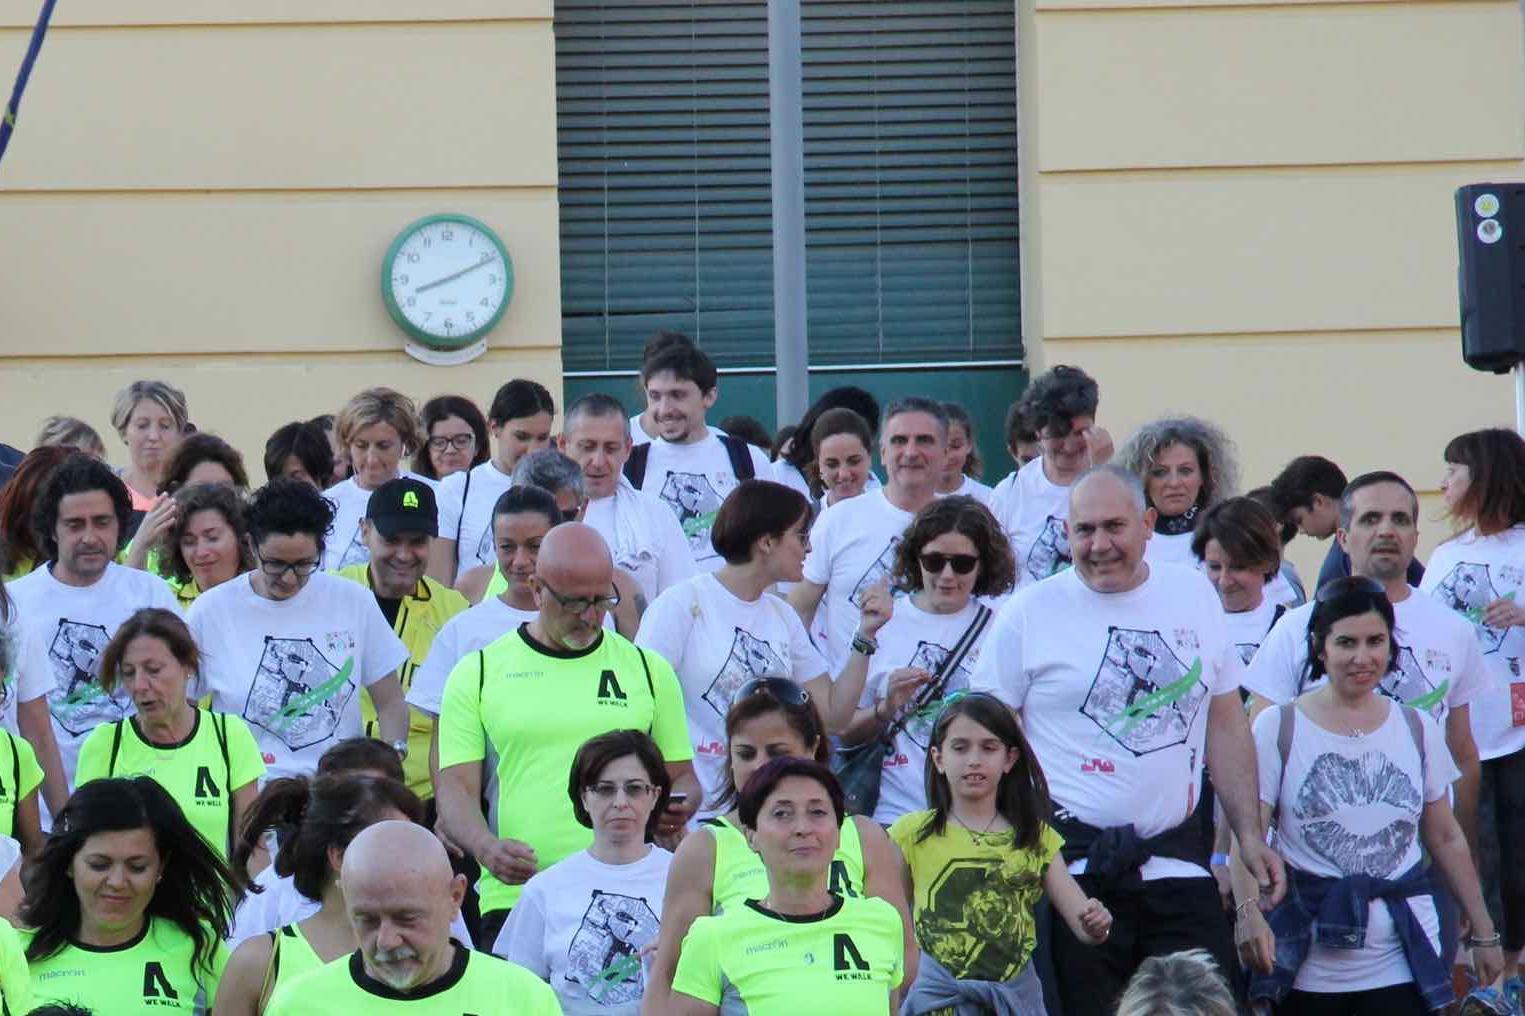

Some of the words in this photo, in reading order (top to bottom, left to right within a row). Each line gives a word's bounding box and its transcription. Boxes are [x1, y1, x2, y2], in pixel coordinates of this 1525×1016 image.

[442, 230, 453, 241] 12
[407, 252, 421, 264] 10
[443, 317, 454, 329] 6
[835, 973, 850, 981] WE
[851, 972, 872, 981] WALK
